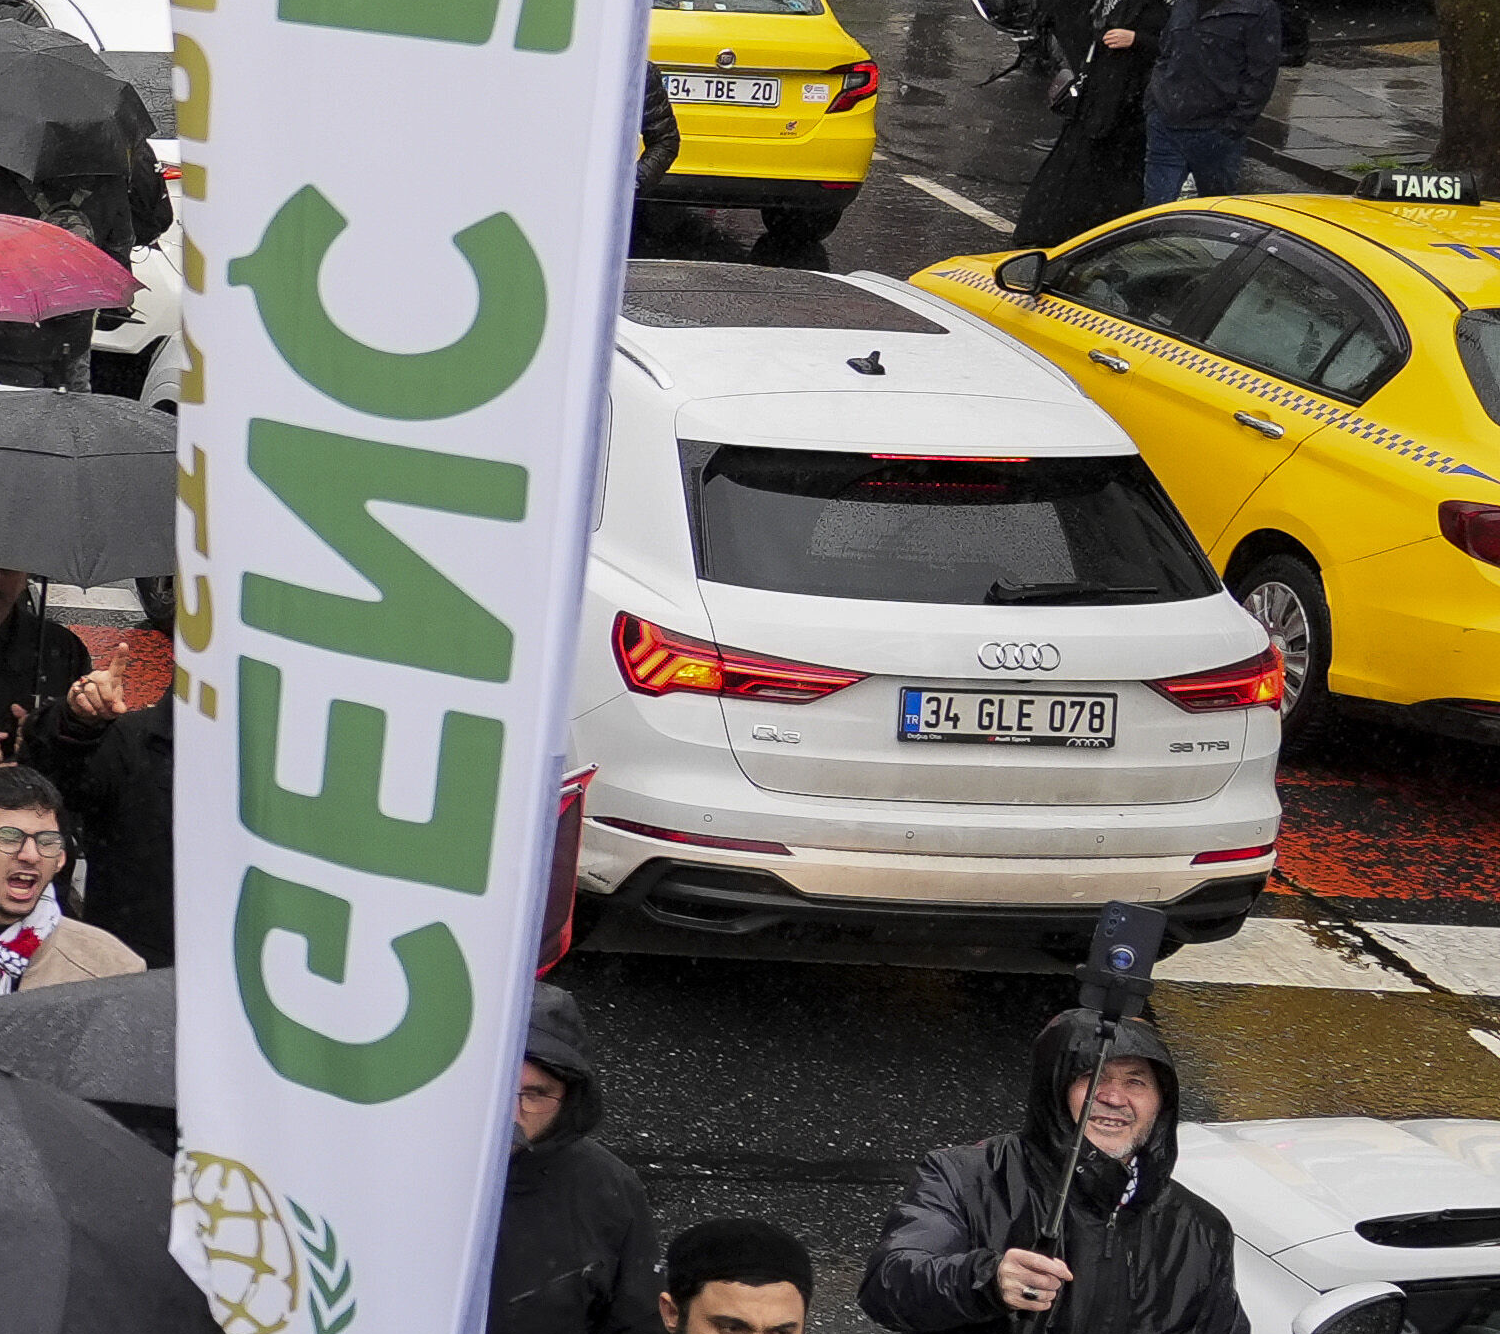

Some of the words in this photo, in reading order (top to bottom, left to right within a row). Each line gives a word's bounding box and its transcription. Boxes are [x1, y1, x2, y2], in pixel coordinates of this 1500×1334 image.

[669, 78, 691, 97] 34
[704, 79, 736, 99] TBE
[751, 82, 772, 100] 20
[905, 714, 919, 726] TR
[924, 696, 961, 730] 34
[977, 698, 1035, 732] GLE
[1048, 700, 1106, 734] 078
[752, 723, 801, 744] Q3
